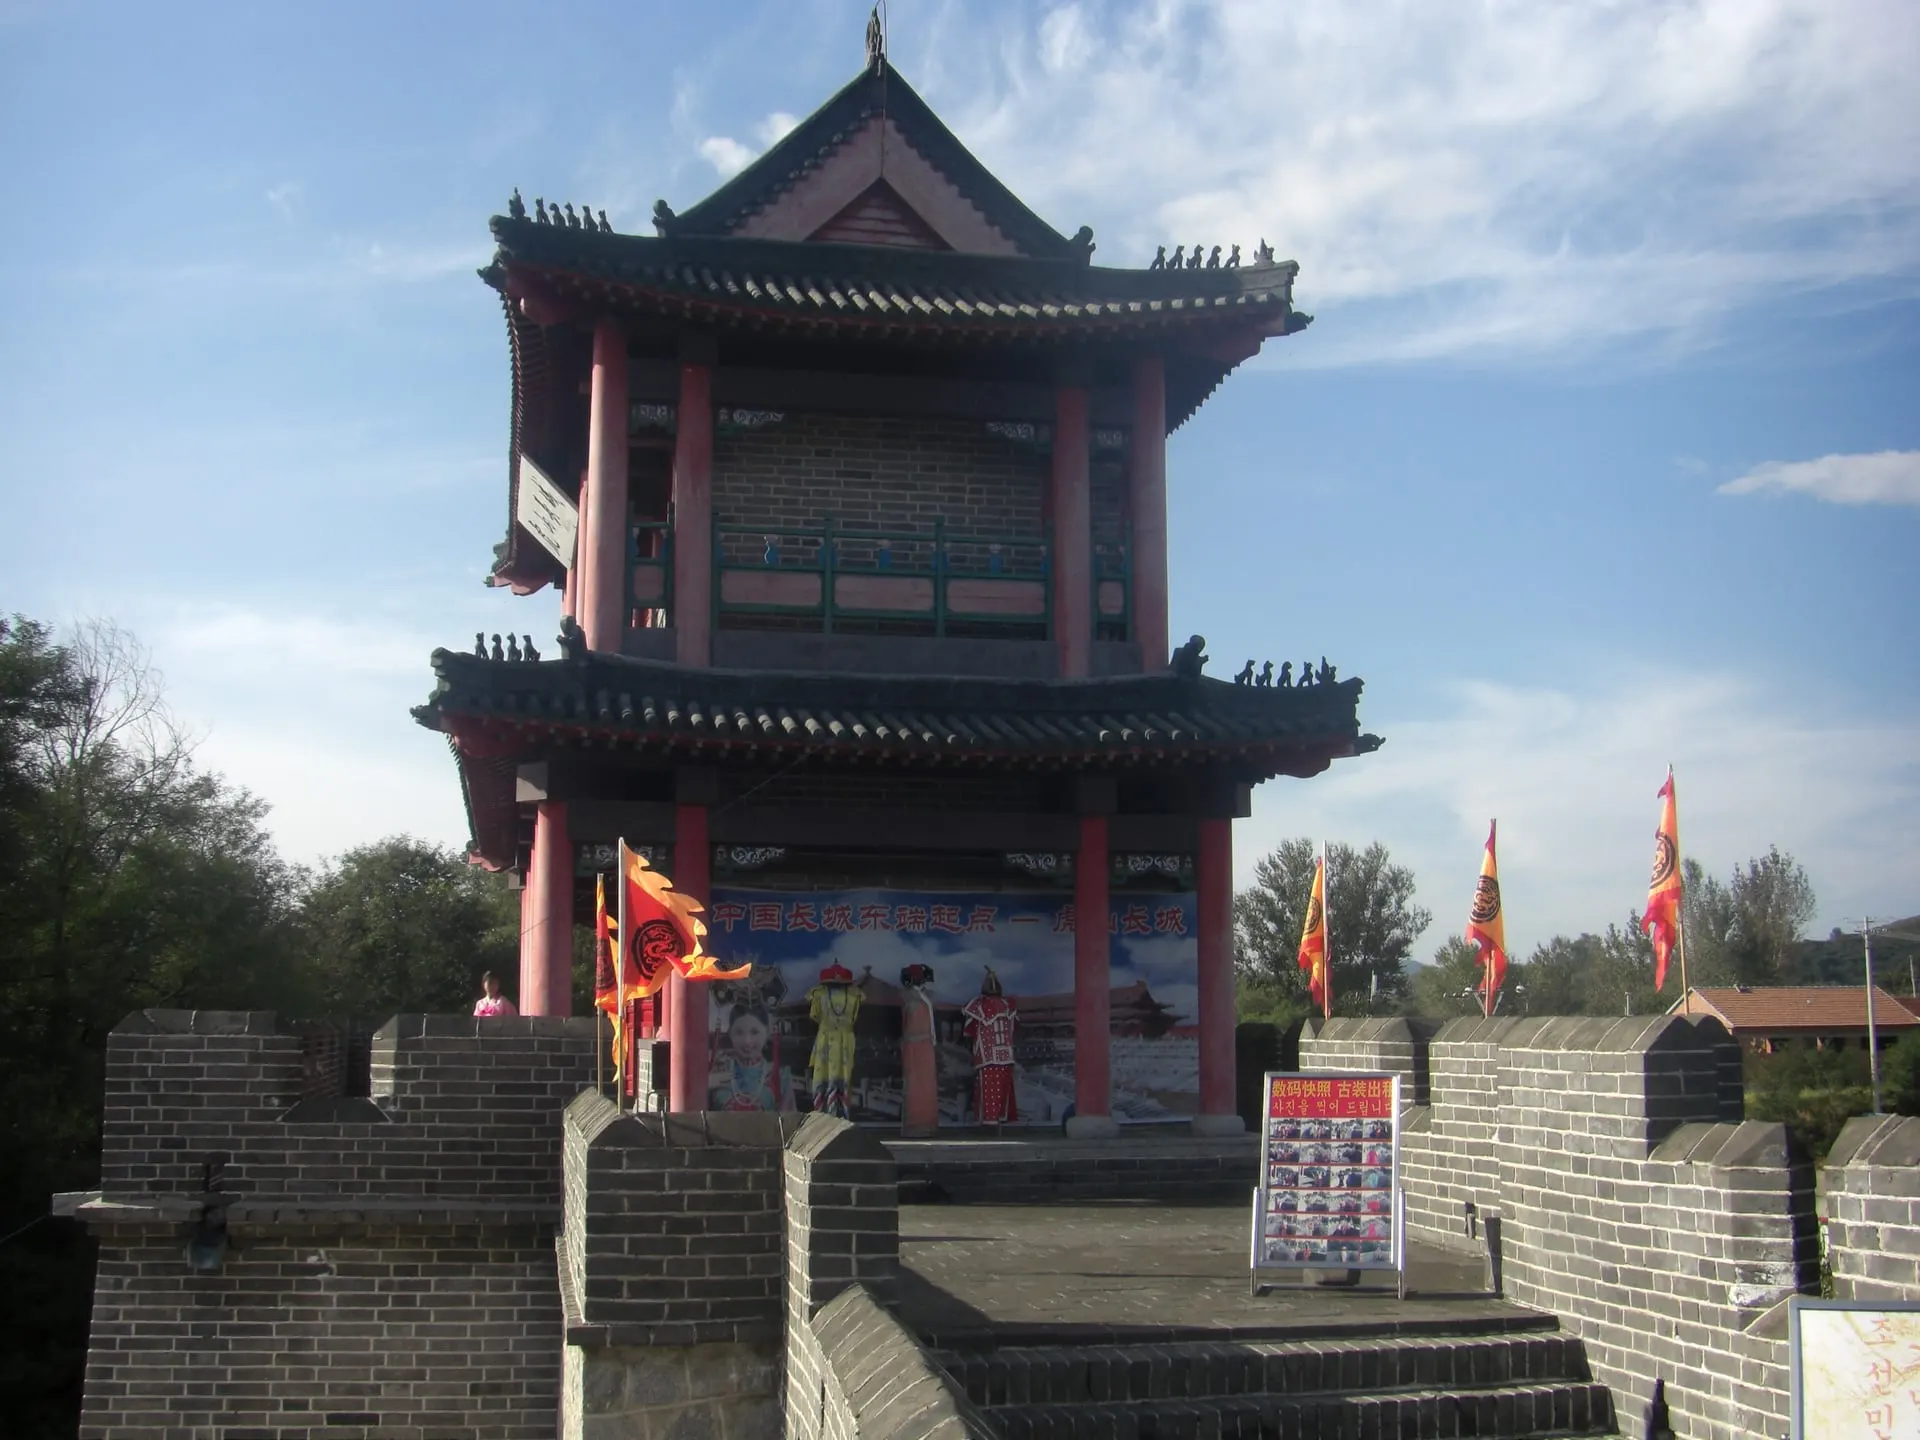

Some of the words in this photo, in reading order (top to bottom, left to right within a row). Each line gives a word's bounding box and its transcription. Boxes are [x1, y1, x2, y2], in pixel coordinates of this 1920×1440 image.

[1052, 905, 1188, 935] 虎长城
[1272, 1080, 1331, 1098] 数码快照
[1273, 1099, 1308, 1115] 사진을
